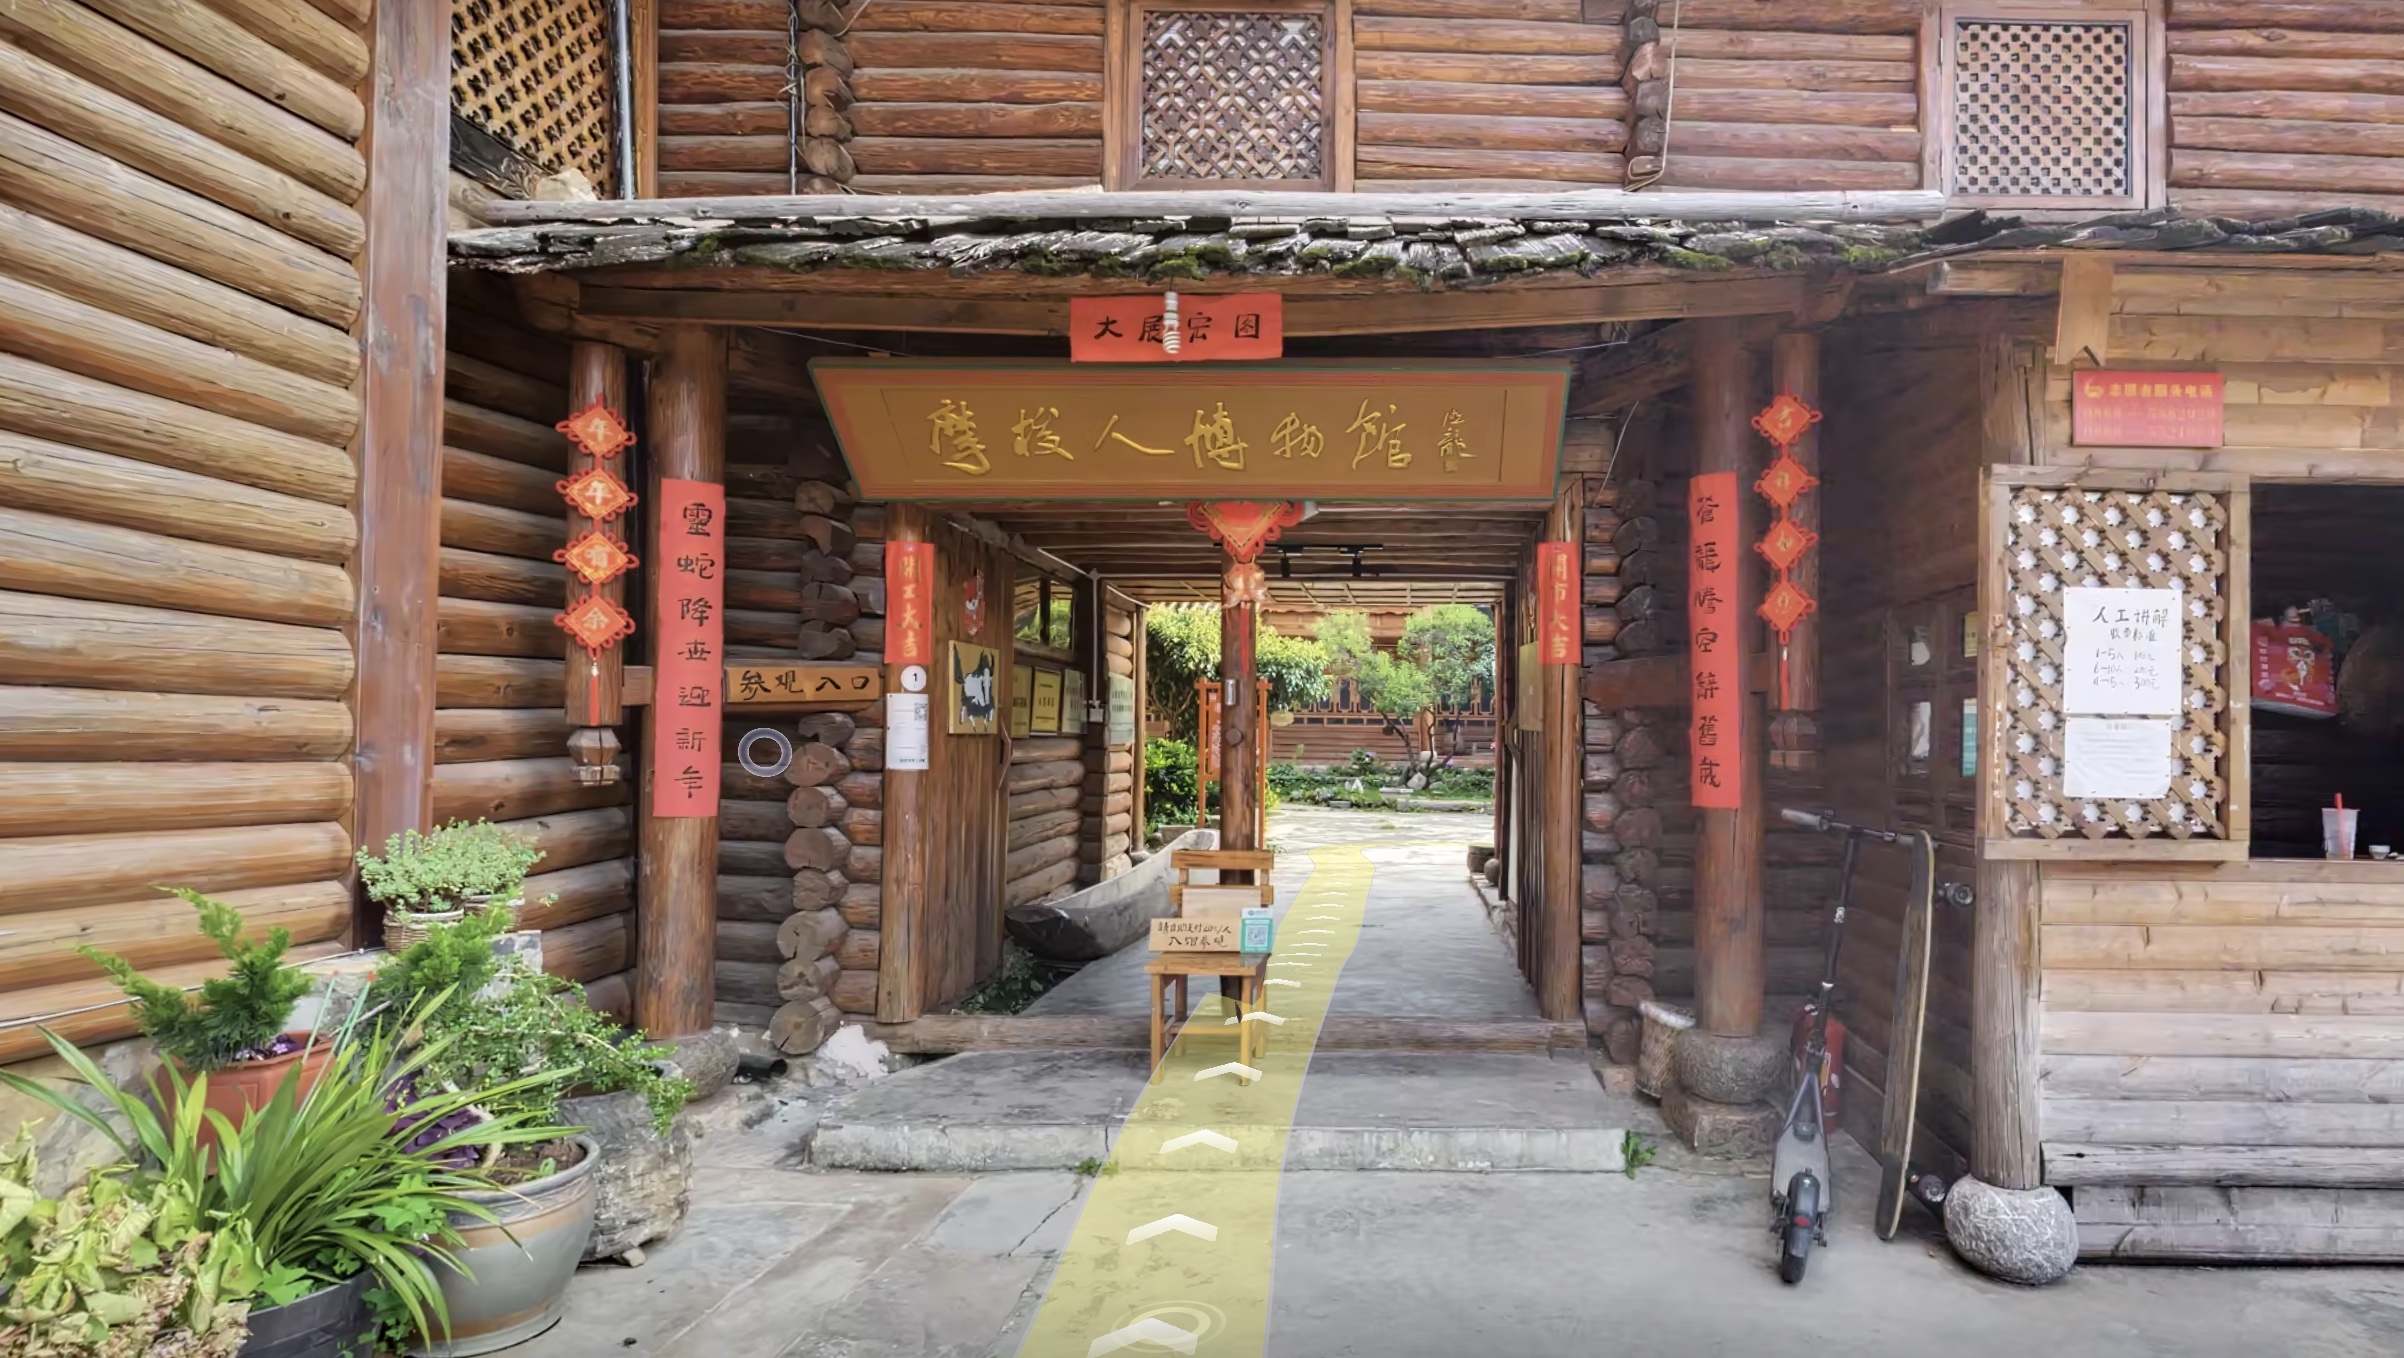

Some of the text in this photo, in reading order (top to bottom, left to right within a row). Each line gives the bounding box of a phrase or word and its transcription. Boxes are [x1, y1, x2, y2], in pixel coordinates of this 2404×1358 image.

[1094, 312, 1260, 343] 大展宏图
[2093, 606, 2169, 627] 人工讲解
